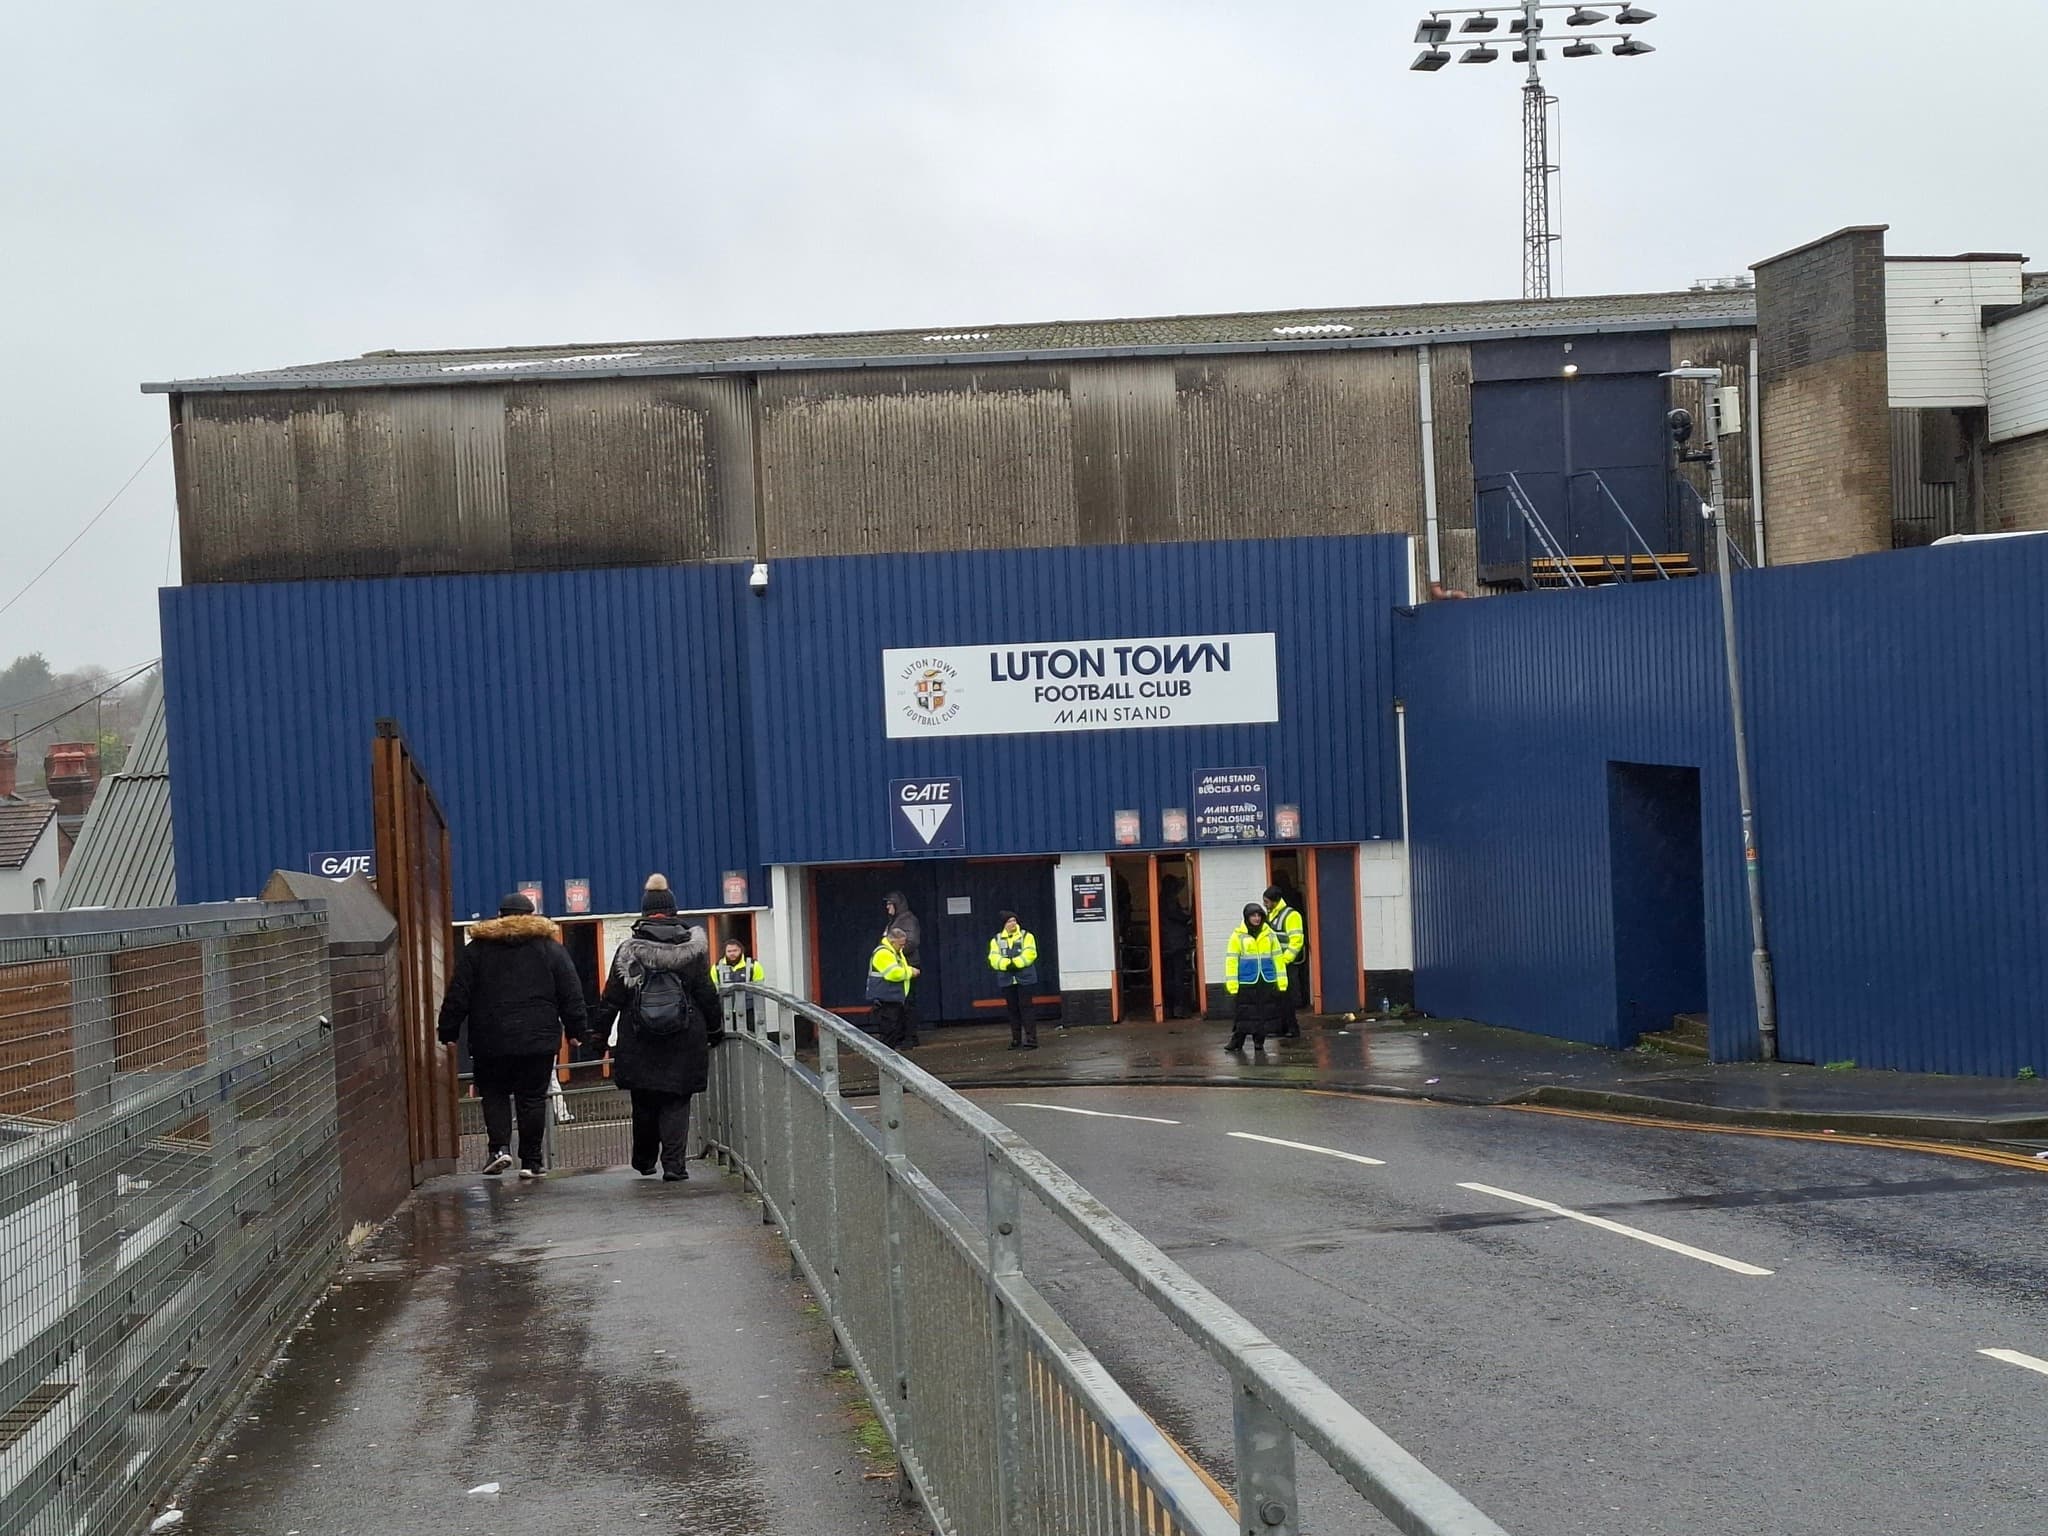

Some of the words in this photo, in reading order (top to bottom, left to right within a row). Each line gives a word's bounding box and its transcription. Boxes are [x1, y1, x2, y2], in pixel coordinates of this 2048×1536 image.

[901, 658, 929, 680] LUTON
[932, 658, 958, 679] TOWN
[990, 647, 1104, 682] LUTON
[1113, 642, 1231, 675] TOWN
[1034, 683, 1134, 702] FOOTBALL
[1139, 680, 1191, 699] CLUB
[902, 705, 941, 726] FOOTBALL
[941, 703, 961, 722] CLUB
[1054, 706, 1107, 724] MAIN
[1113, 704, 1171, 722] STAND
[1202, 775, 1228, 784] MAIN
[1229, 774, 1256, 783] STAND
[901, 783, 951, 802] GATE
[1198, 785, 1232, 794] BLOCKS
[1233, 785, 1240, 793] A
[1253, 784, 1261, 792] G
[918, 808, 936, 827] 11
[1204, 805, 1229, 814] MAIN
[1230, 804, 1257, 813] STAND
[1206, 814, 1256, 824] ENCLOSURE
[321, 856, 371, 875] GATE
